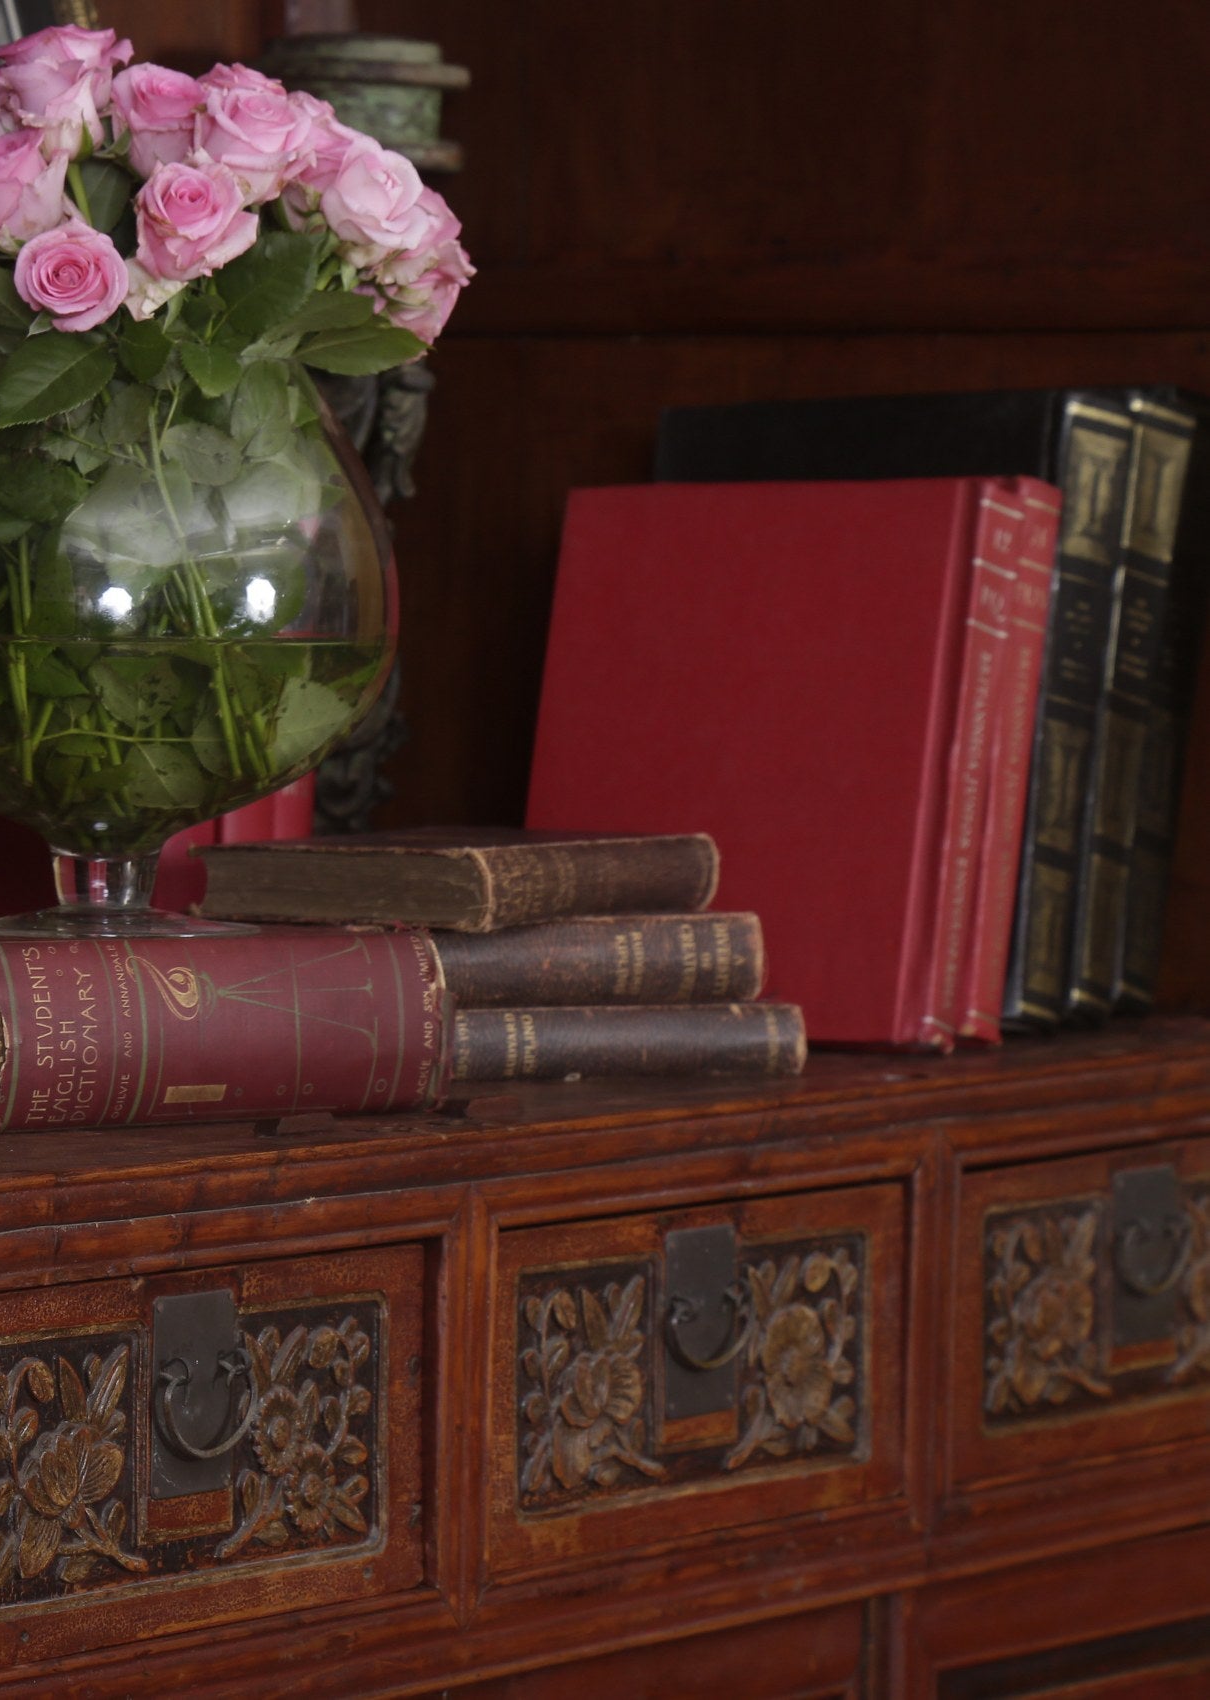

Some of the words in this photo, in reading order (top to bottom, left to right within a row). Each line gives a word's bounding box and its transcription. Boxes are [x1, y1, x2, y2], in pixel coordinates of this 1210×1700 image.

[108, 945, 132, 1018] ANNANDALE
[48, 1021, 76, 1122] ENGLISH
[70, 967, 98, 1121] DICTIONARY
[124, 1031, 133, 1057] AND
[414, 1058, 432, 1098] ACKIE
[424, 1021, 434, 1048] AND
[504, 1012, 518, 1077] RUDYARD
[521, 1014, 537, 1074] KIPLING
[25, 1088, 50, 1123] THE
[111, 1074, 130, 1119] OGILVIE
